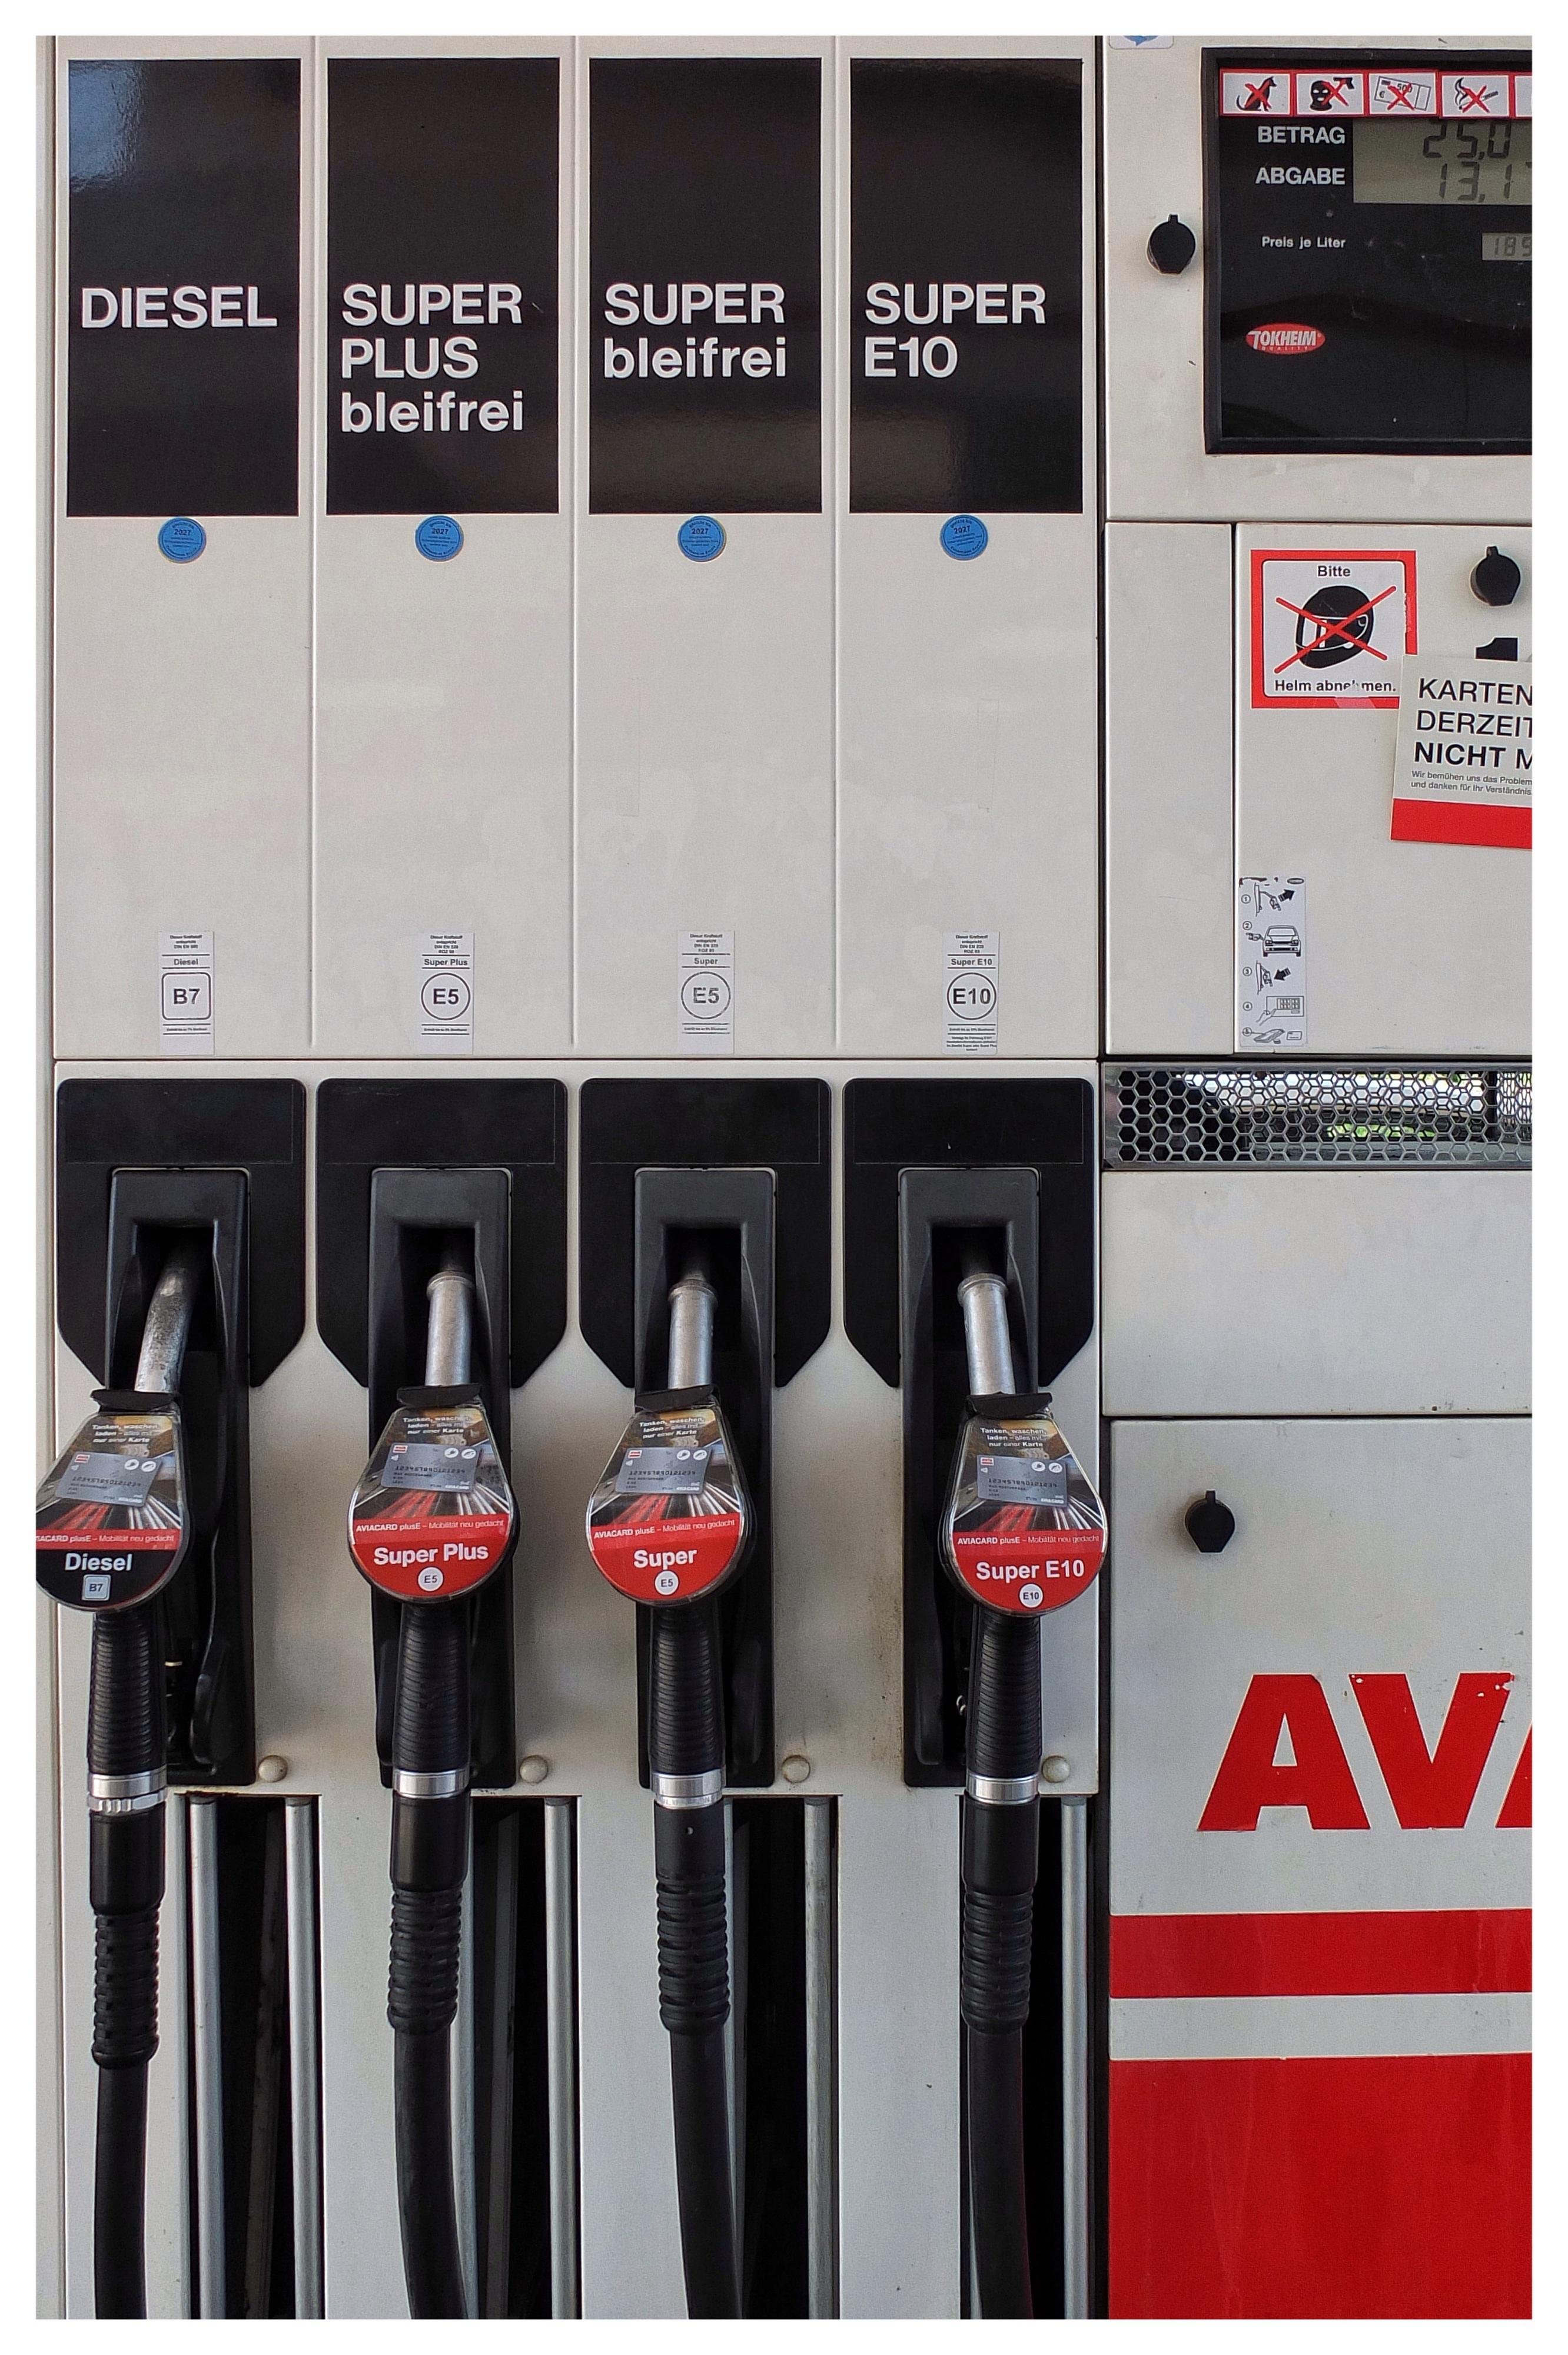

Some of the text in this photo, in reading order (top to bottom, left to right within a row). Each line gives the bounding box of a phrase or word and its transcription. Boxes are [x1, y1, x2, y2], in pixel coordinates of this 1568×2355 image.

[1257, 125, 1346, 144] BETRAG
[1255, 167, 1346, 185] ABGABE
[1439, 161, 1532, 203] 13,1
[1261, 236, 1346, 250] Preis je Liter
[81, 286, 278, 328] DIESEL
[342, 283, 522, 326] SUPER
[604, 283, 786, 325] SUPER
[865, 283, 1046, 325] SUPER
[1247, 330, 1316, 350] TOKHEIM
[341, 337, 479, 379] PLUS
[604, 336, 786, 378] bleifrei
[864, 336, 958, 378] E10
[341, 391, 523, 433] bleifrei
[954, 525, 970, 534] 2027
[1317, 565, 1351, 578] Bitte
[1275, 679, 1311, 691] Helm
[1418, 678, 1532, 706] KARTEN
[1416, 709, 1532, 738] DERZEIT
[1414, 741, 1506, 768] NICHT
[1427, 771, 1464, 781] bemühen
[1500, 777, 1532, 785] Problem
[1428, 781, 1457, 790] danken
[424, 958, 448, 967] Super
[694, 957, 718, 966] Super
[951, 958, 975, 966] Super
[173, 988, 200, 1004] B7
[433, 988, 459, 1004] E5
[693, 987, 720, 1004] E5
[952, 987, 991, 1004] E10
[356, 1524, 398, 1532] AVIACARD
[400, 1523, 421, 1531] plusE
[475, 1520, 504, 1528] gedacht
[594, 1529, 633, 1539] AVIACARD
[634, 1527, 655, 1536] plusE
[707, 1520, 735, 1530] gedacht
[1000, 1536, 1020, 1545] plusE
[1072, 1535, 1099, 1543] gedacht
[65, 1553, 132, 1571] Diesel
[374, 1543, 489, 1567] Super Plus
[633, 1548, 697, 1570] Super
[424, 1575, 437, 1583] E5
[976, 1560, 1084, 1583] Super E10
[89, 1583, 103, 1591] B7
[660, 1578, 673, 1587] E5
